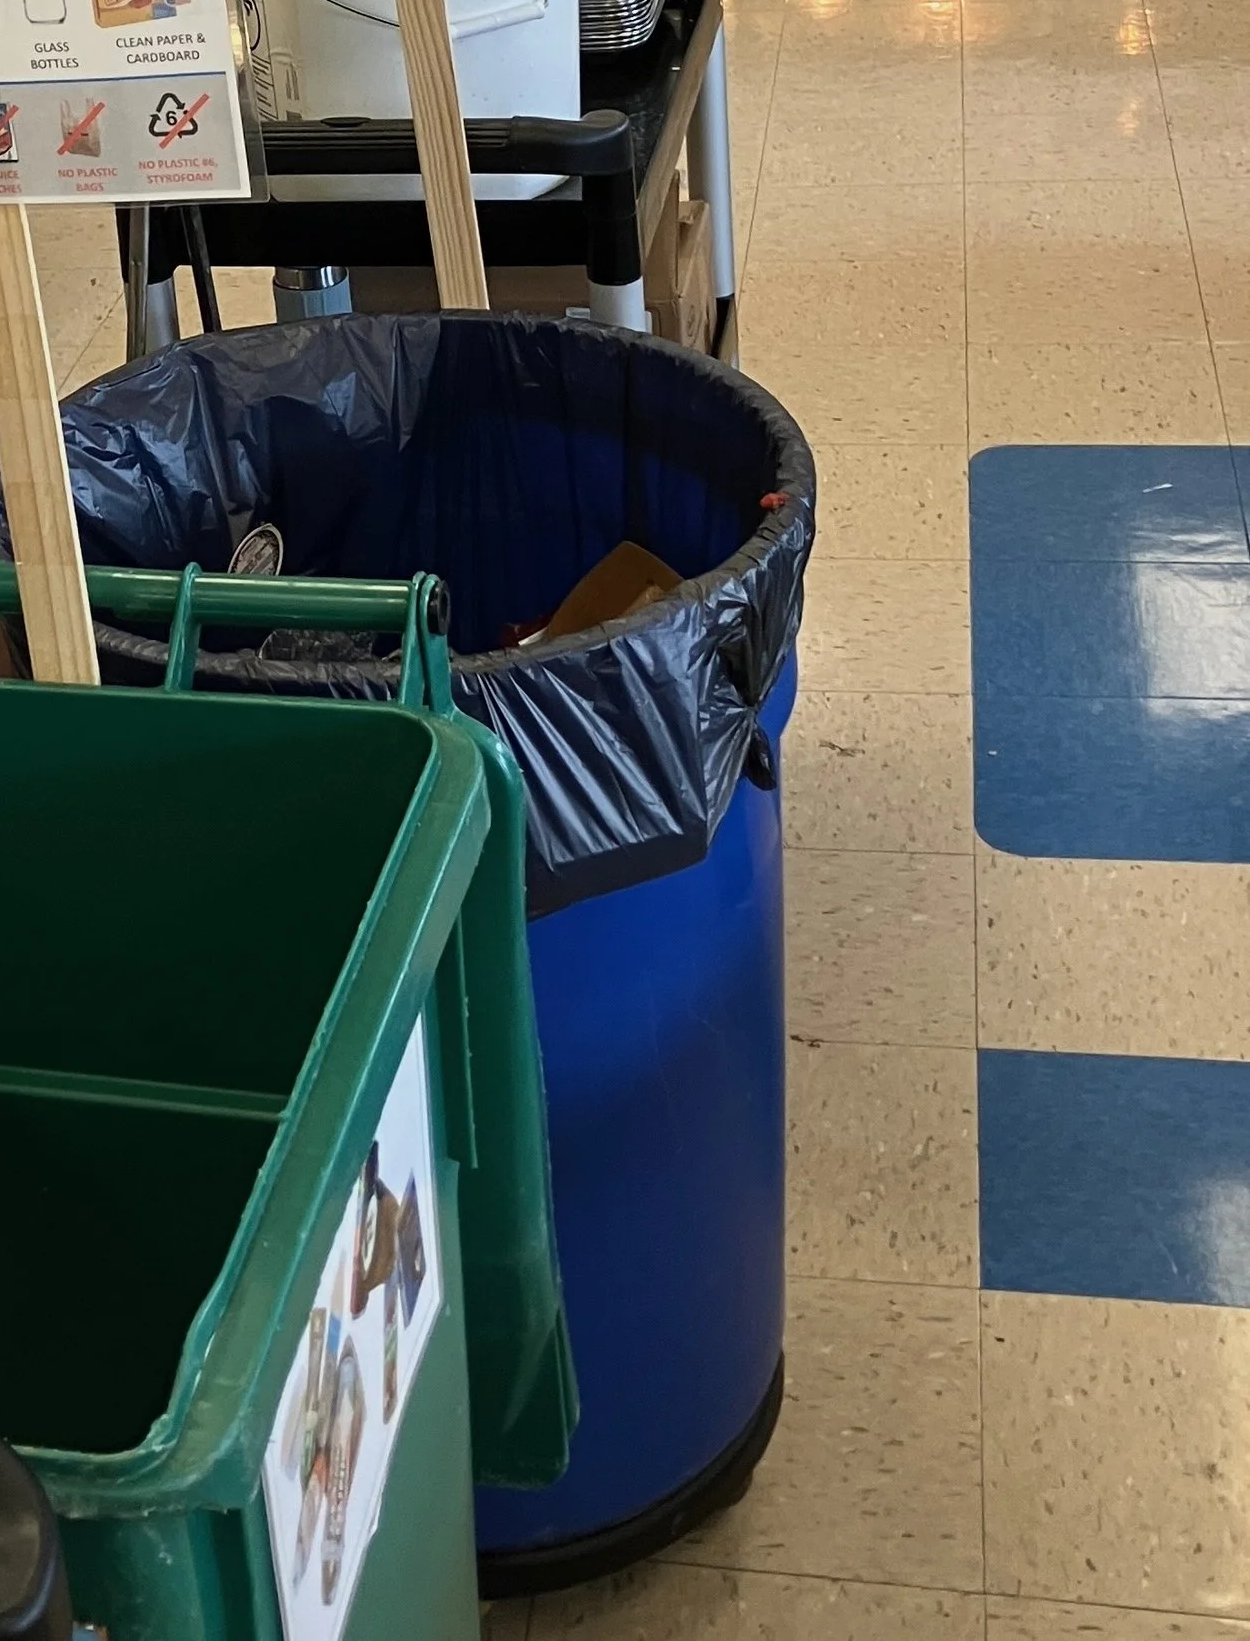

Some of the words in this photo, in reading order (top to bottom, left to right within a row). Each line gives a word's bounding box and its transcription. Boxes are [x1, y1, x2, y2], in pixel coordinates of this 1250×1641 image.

[115, 36, 154, 49] CLEAN
[156, 34, 194, 46] PAPER
[197, 32, 206, 44] &
[34, 41, 70, 53] GLASS
[30, 57, 79, 69] BOTTLES
[126, 50, 200, 64] CARDBOARD
[165, 110, 178, 126] 6
[138, 160, 156, 170] NO
[157, 159, 199, 170] PLASTIC
[58, 169, 75, 178] NO
[77, 167, 118, 178] PLASTIC
[146, 172, 214, 184] STYROFOAM
[76, 182, 104, 192] BAGS
